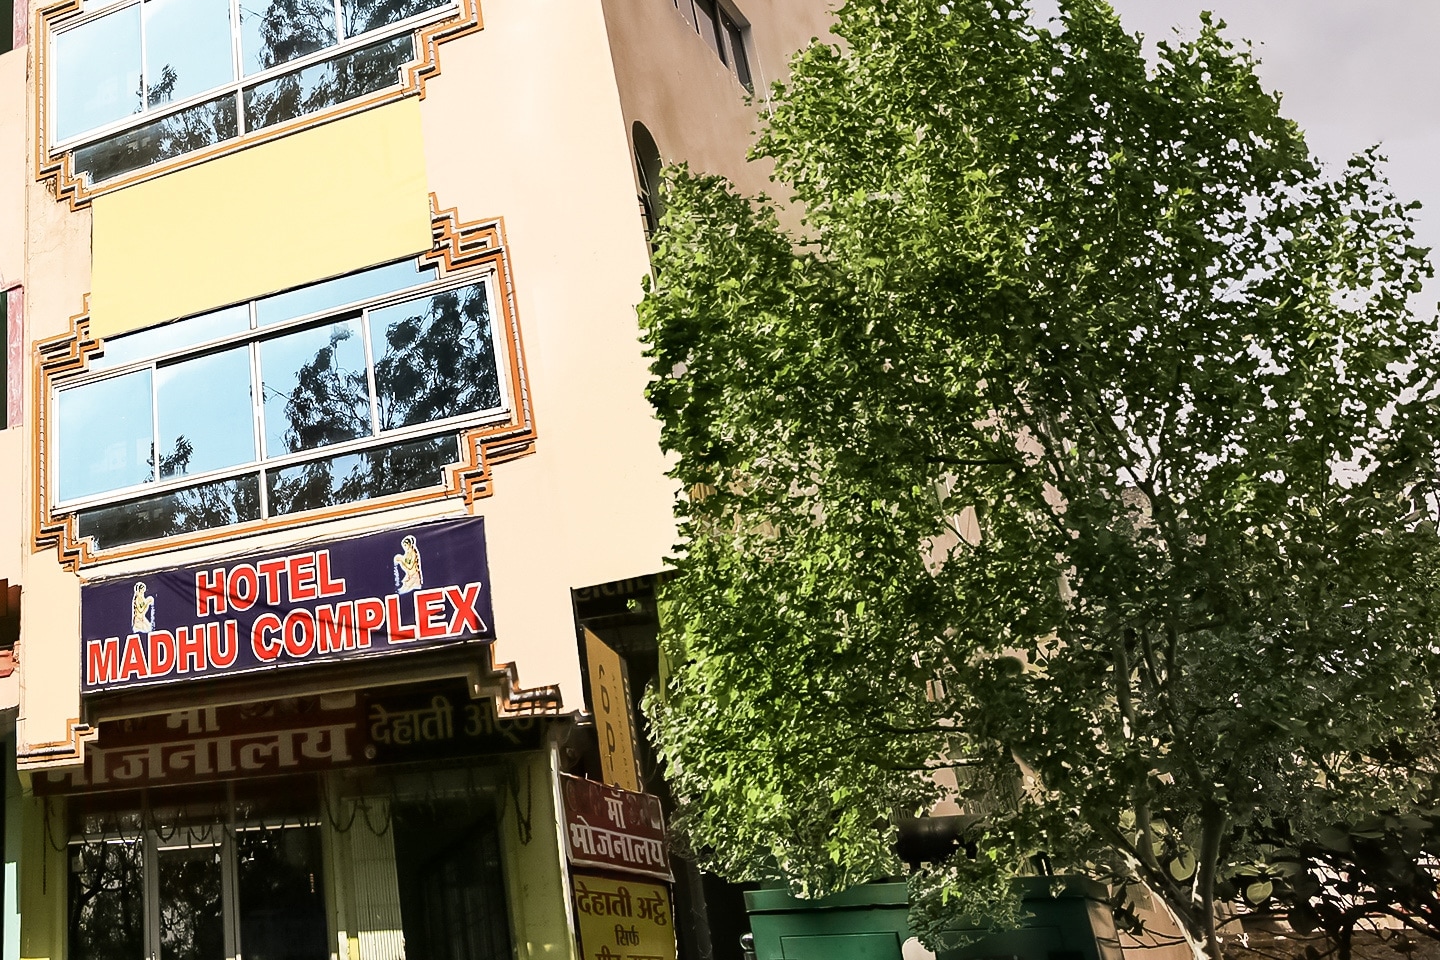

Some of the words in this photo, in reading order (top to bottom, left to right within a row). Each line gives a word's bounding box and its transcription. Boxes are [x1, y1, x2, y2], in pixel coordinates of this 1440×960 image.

[196, 550, 346, 617] HOTEL
[86, 619, 239, 685] MADHU
[251, 582, 488, 661] COMPLEX
[368, 695, 455, 744] देहाती
[570, 815, 666, 868] भोजनालय
[575, 882, 633, 918] देहाती
[614, 924, 640, 947] सिर्फ
